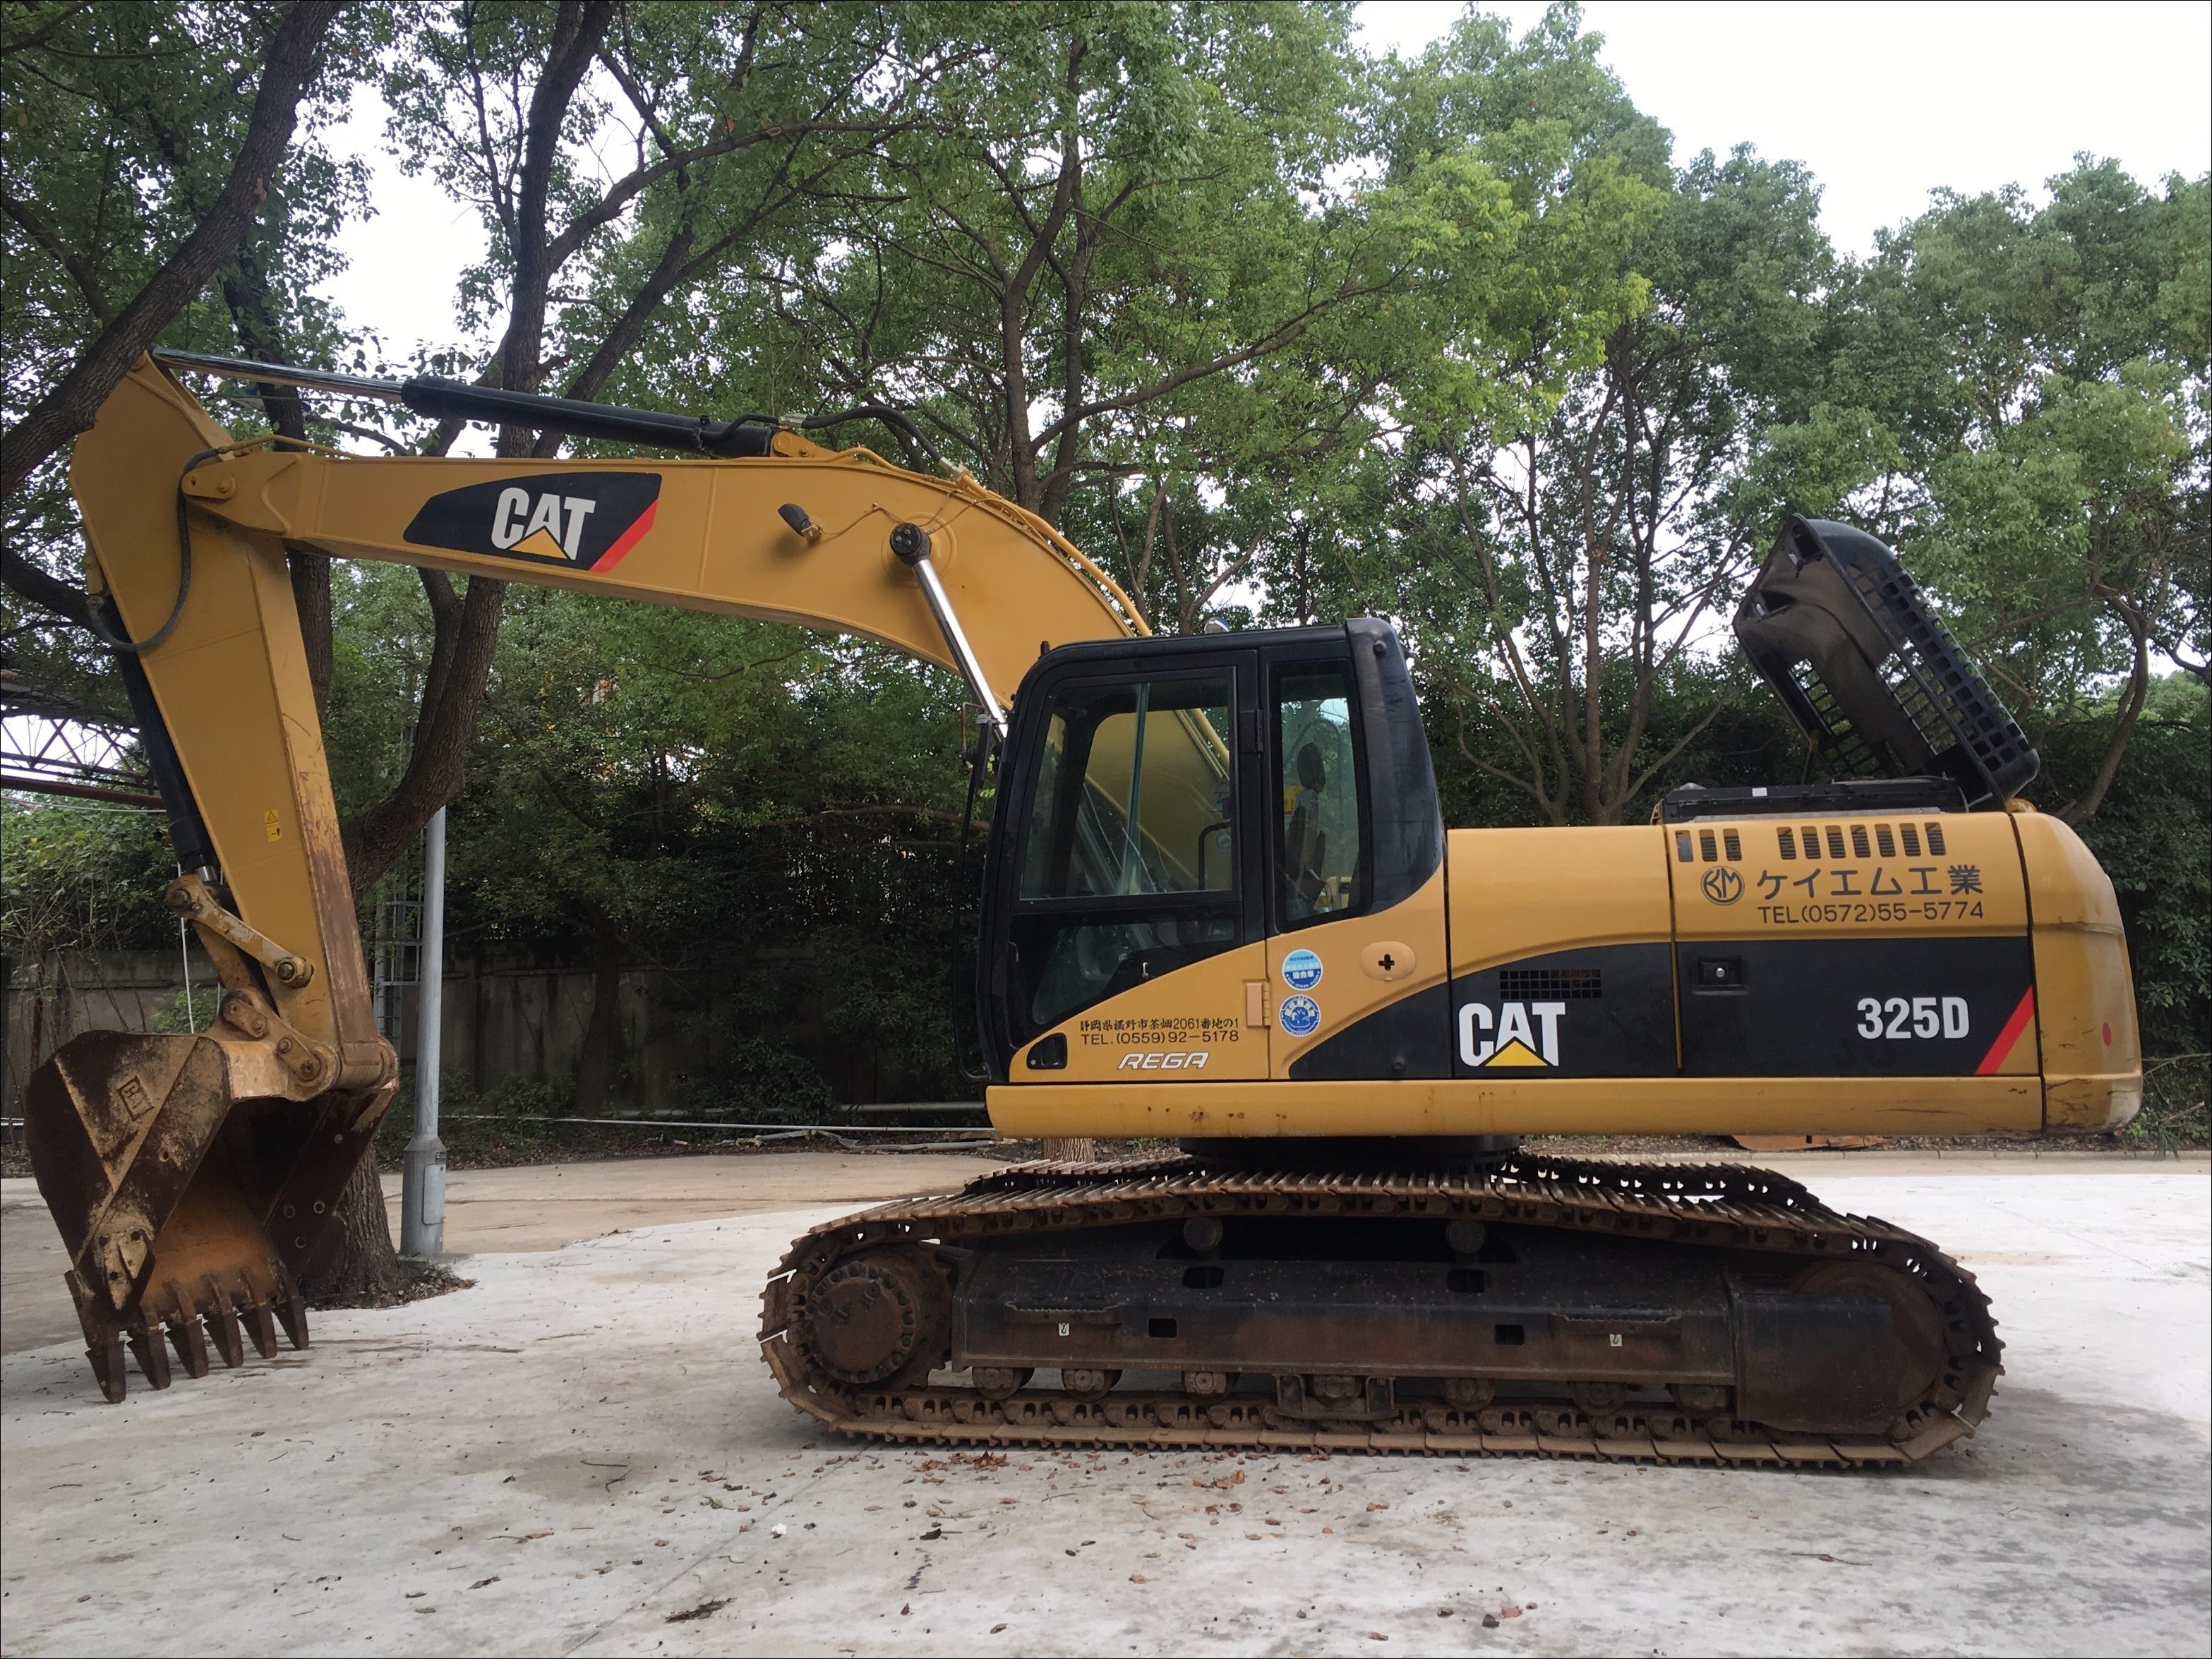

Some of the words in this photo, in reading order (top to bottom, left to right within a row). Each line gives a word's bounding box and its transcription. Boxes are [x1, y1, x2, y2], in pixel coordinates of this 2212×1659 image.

[491, 487, 596, 560] CAT
[1757, 864, 1984, 900] ケイエム工業
[1458, 1002, 1566, 1067] CAT
[1857, 997, 1970, 1039] 325D
[1117, 1051, 1210, 1070] REGA
